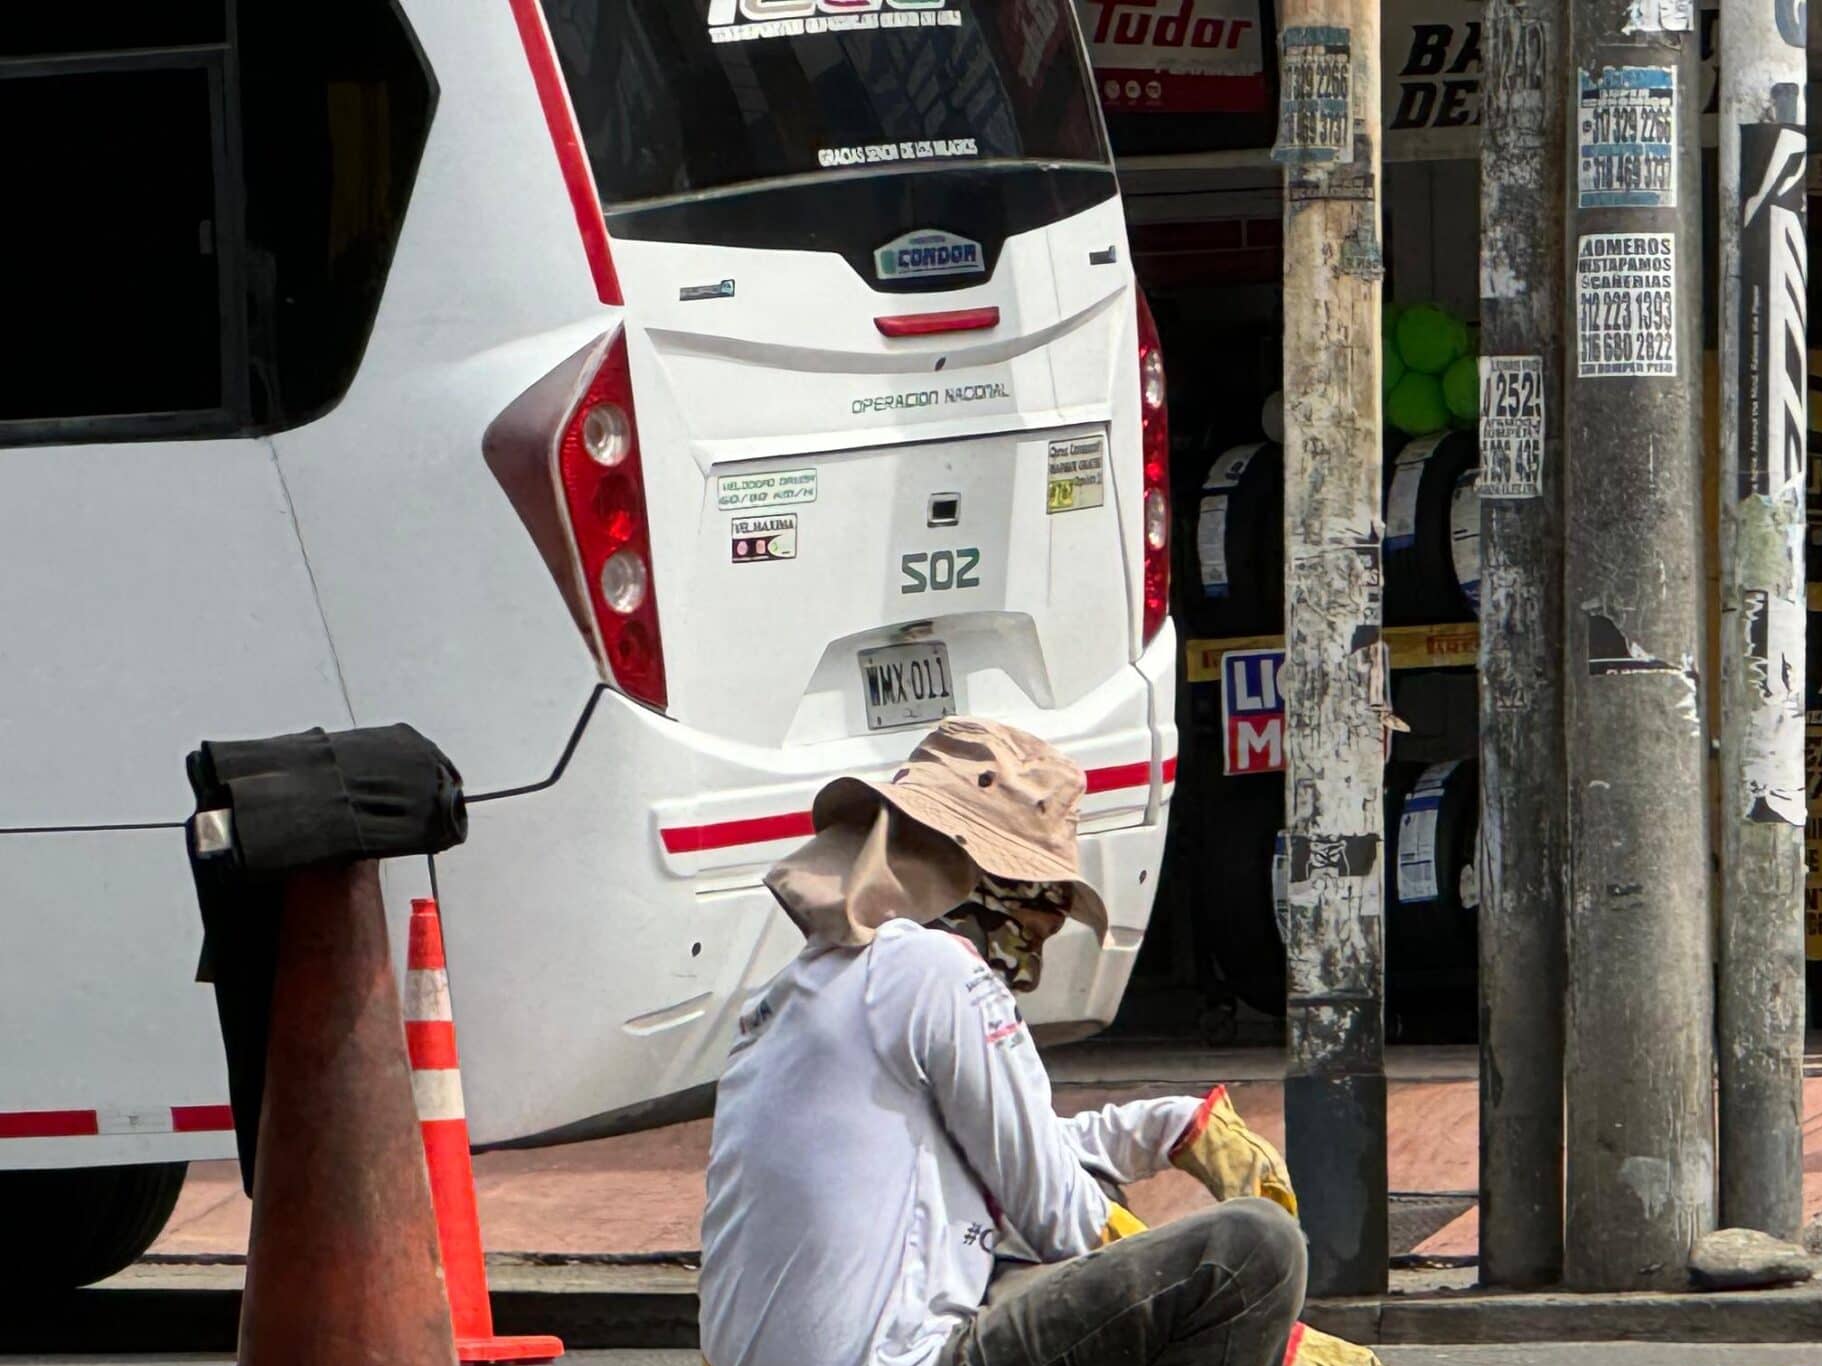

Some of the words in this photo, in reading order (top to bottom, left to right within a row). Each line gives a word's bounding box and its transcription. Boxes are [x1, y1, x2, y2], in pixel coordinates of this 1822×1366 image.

[1091, 0, 1253, 49] Tudor
[897, 244, 977, 269] CONDOR
[901, 547, 980, 594] 502
[1233, 658, 1289, 711] LI
